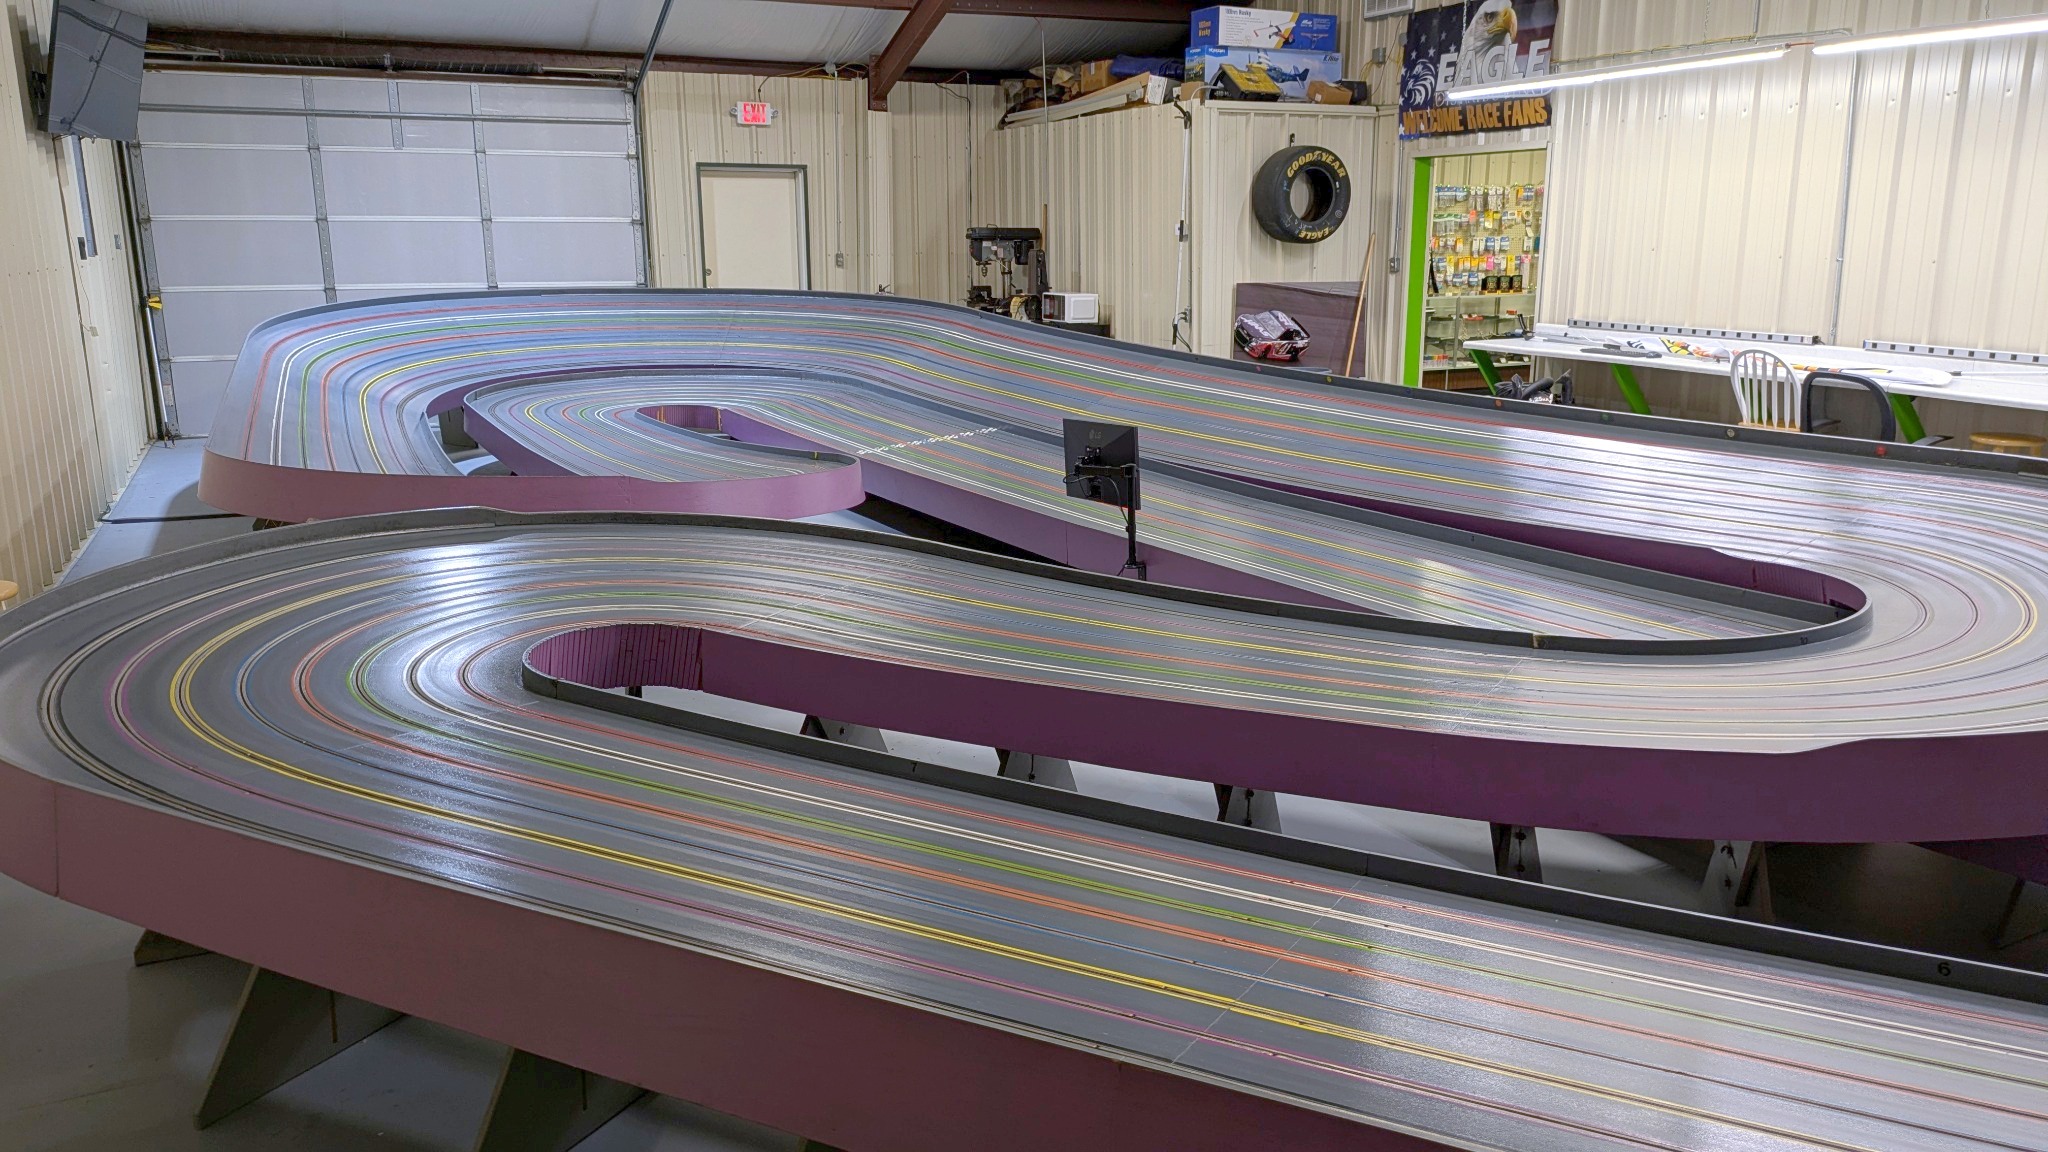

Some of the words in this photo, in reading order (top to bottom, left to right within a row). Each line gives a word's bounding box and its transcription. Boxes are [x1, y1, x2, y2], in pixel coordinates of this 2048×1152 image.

[1436, 39, 1550, 92] EAGLE
[743, 102, 767, 123] EXIT
[1404, 106, 1464, 134] WELCOME
[1467, 103, 1502, 129] RACE
[1504, 98, 1548, 127] FANS
[1286, 150, 1347, 178] GOODYEAR
[1299, 227, 1329, 240] EAGLE
[1277, 343, 1292, 355] 41
[1938, 961, 1951, 977] 6
